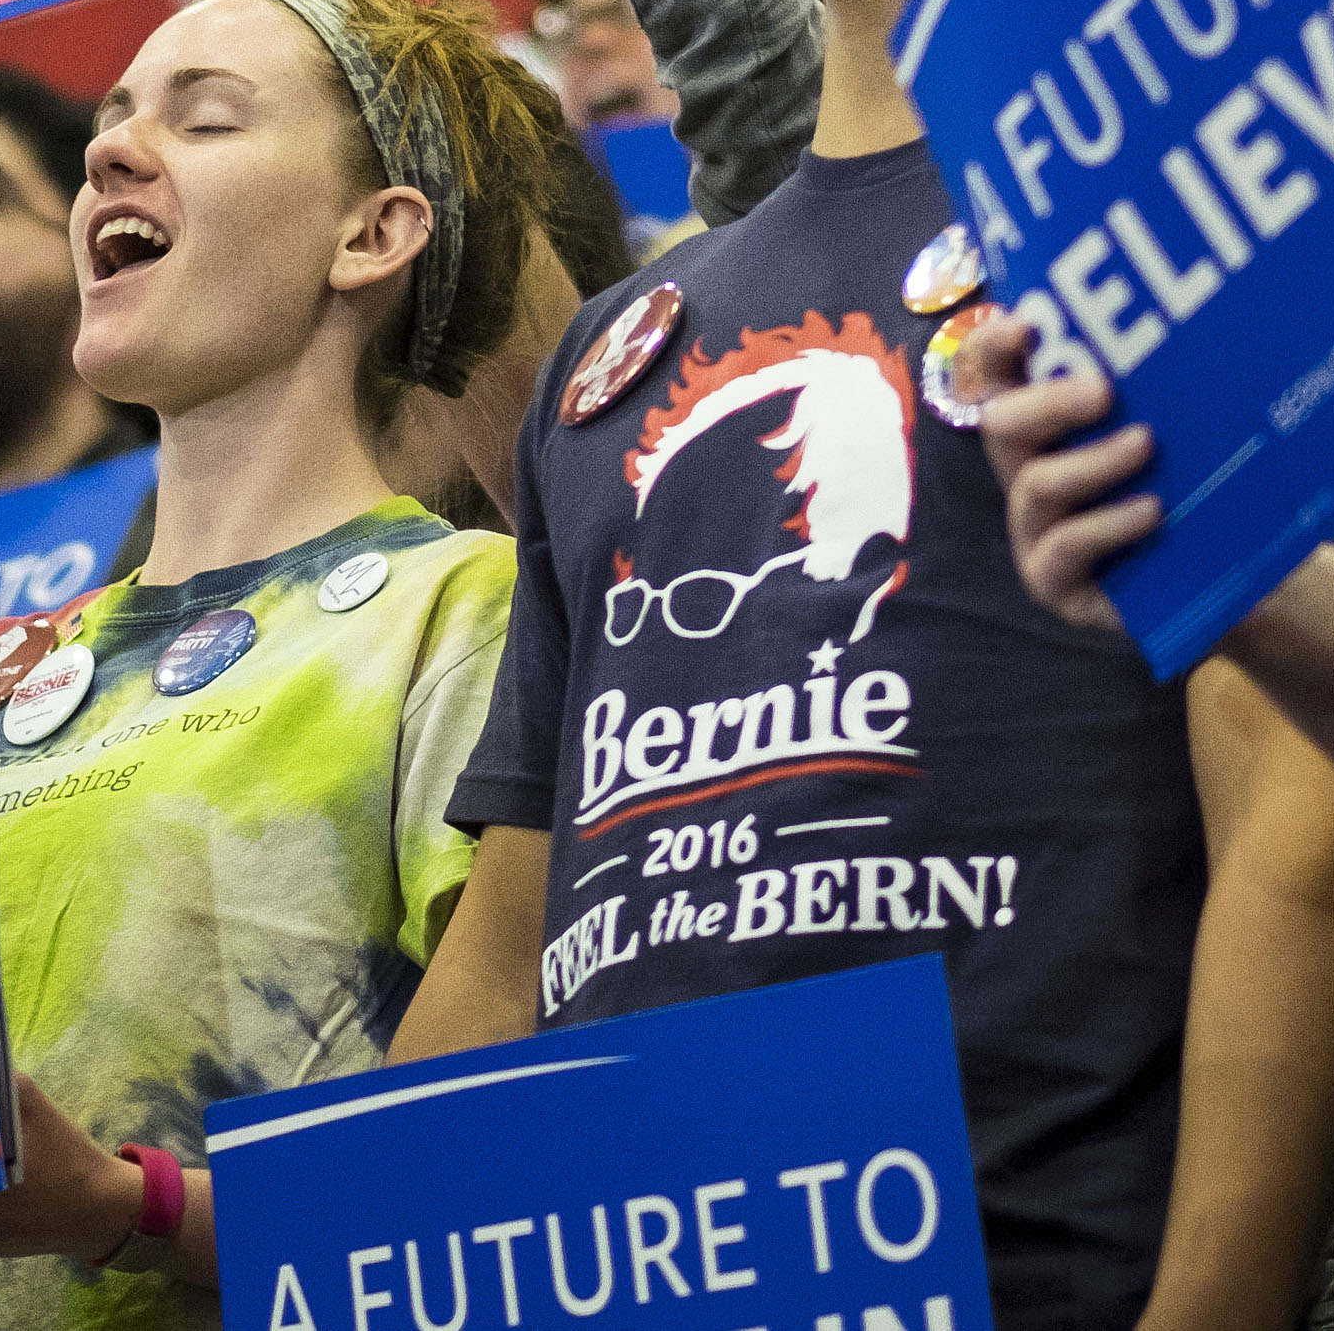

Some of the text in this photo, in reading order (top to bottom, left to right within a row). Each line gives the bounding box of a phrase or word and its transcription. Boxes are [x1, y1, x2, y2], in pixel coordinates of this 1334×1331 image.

[963, 161, 1023, 255] A
[182, 706, 261, 733] who
[579, 640, 913, 810] Bernie
[641, 814, 758, 878] 2016
[541, 856, 1018, 1018] FEEL the BERN!
[269, 1147, 939, 1331] A FUTURE TO
